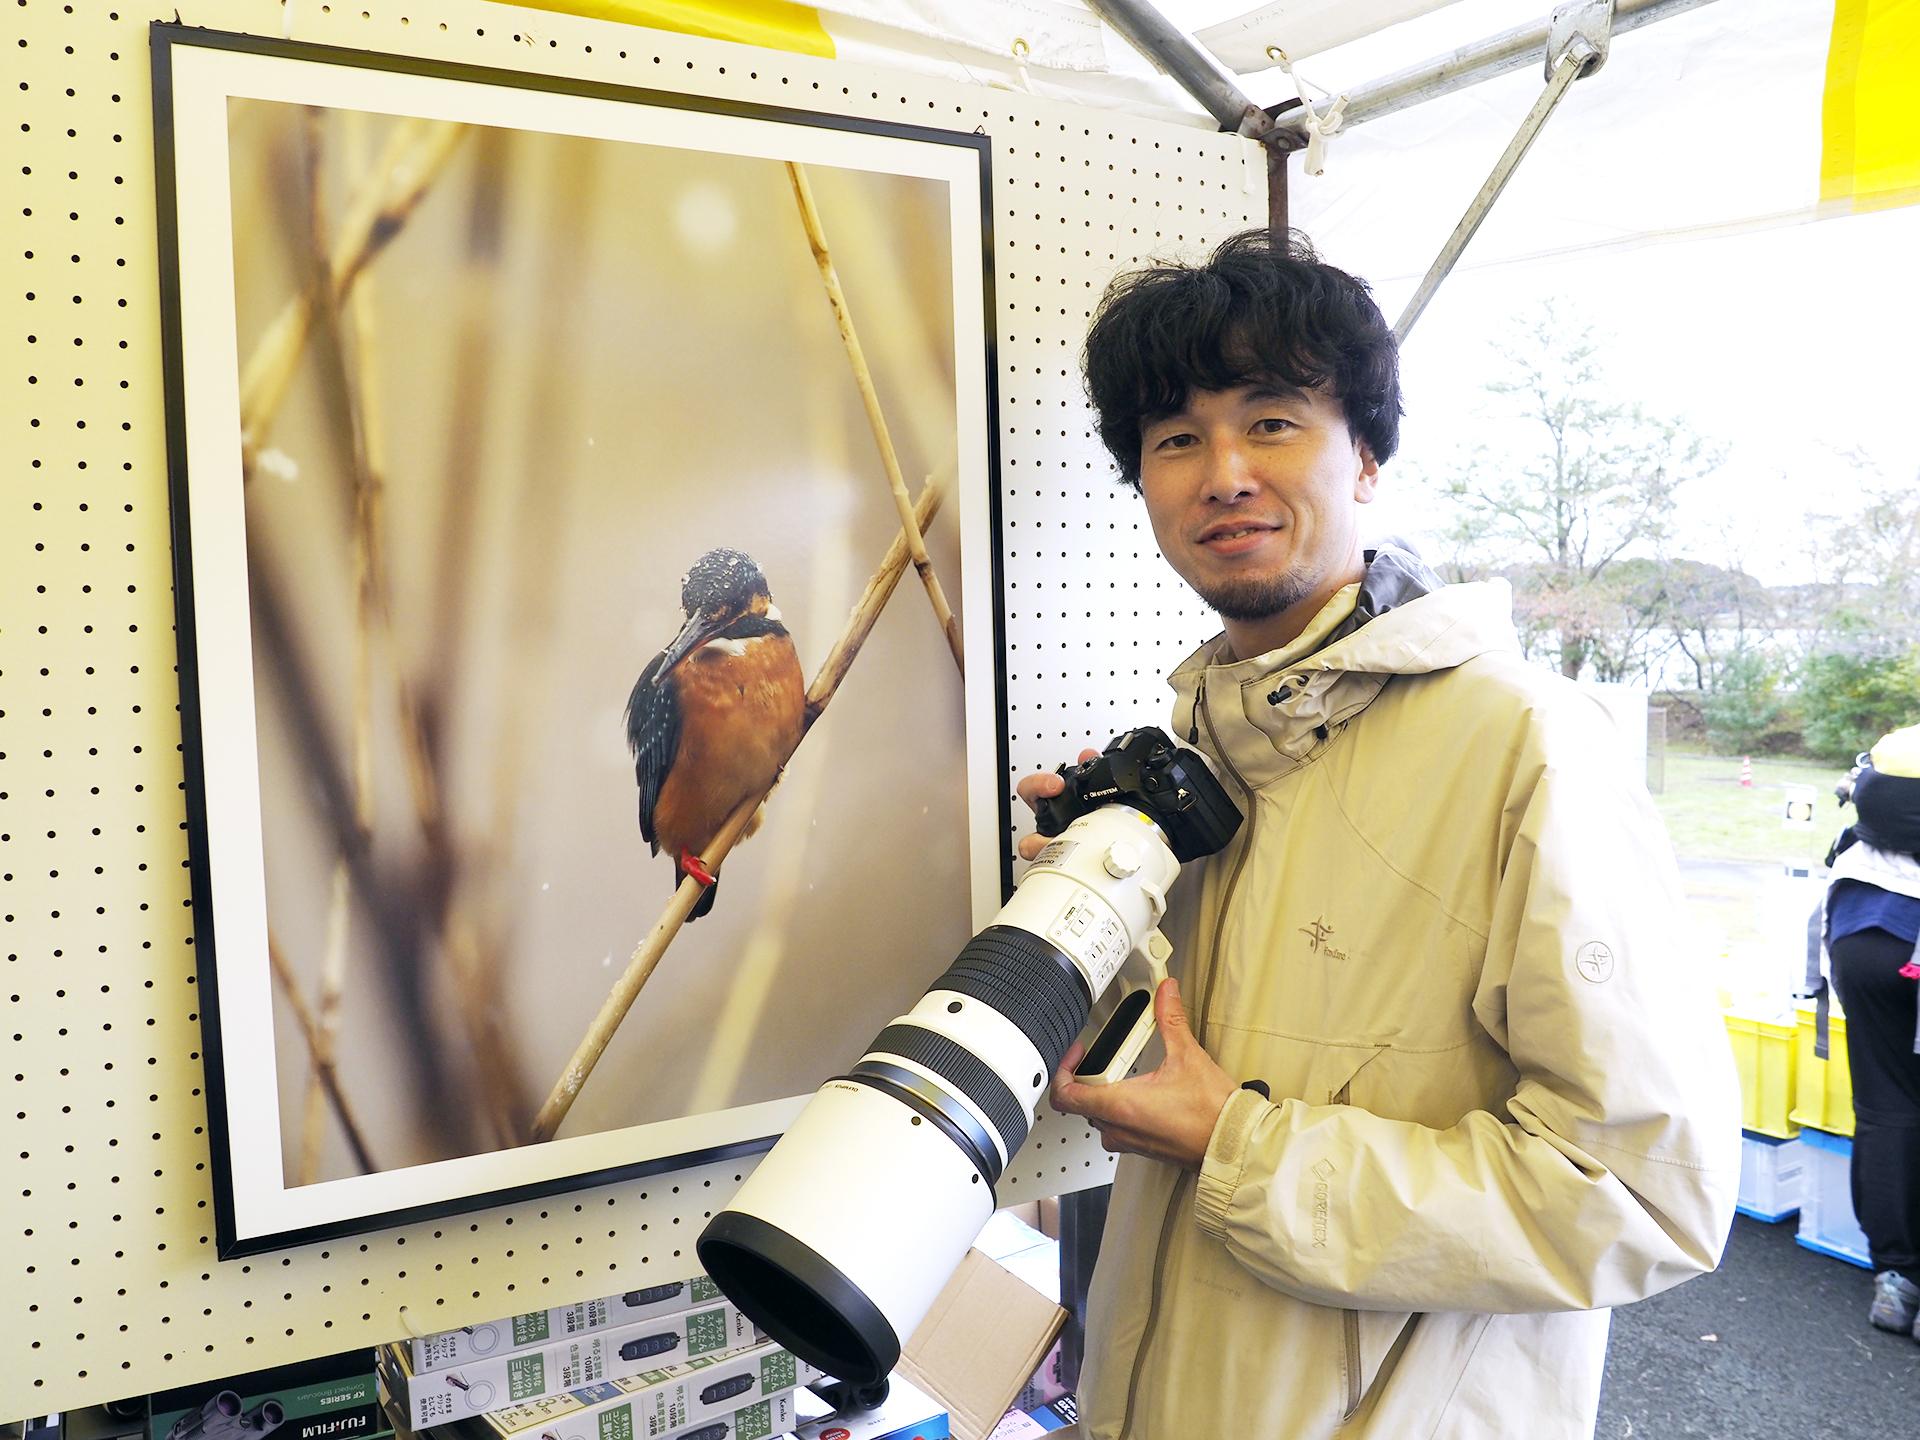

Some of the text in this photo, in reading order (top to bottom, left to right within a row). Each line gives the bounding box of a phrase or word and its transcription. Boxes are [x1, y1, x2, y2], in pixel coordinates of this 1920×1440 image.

[566, 1311, 576, 1333] 3段階
[588, 1302, 597, 1327] 10段階
[596, 1298, 606, 1324] さ調整
[697, 1316, 706, 1352] かんたん
[706, 1314, 716, 1349] スイッチで
[716, 1317, 725, 1342] 手元の
[736, 1312, 744, 1337] Kenko
[432, 1344, 440, 1361] しても
[448, 1336, 456, 1358] そのまま
[592, 1338, 602, 1378] 明るさ調整
[523, 1360, 532, 1395] コンパクト
[532, 1362, 542, 1387] 便利な
[562, 1366, 572, 1388] 3段階
[570, 1344, 581, 1386] 色温度調整
[584, 1356, 593, 1382] 10段階
[770, 1356, 780, 1391] かんたん
[779, 1353, 788, 1386] スイッチで
[786, 1354, 795, 1379] 手元の
[297, 1384, 365, 1401] Compact Binoculars
[510, 1362, 524, 1398] 三脚付き
[320, 1390, 364, 1406] KF SERIES
[428, 1396, 436, 1418] としても
[436, 1394, 444, 1415] クリップ
[444, 1392, 452, 1414] そのまま
[676, 1385, 686, 1426] 明るさ調整
[420, 1398, 428, 1424] 使用可能
[656, 1392, 666, 1433] 色温度調整
[669, 1403, 678, 1429] 10段階
[761, 1404, 770, 1428] 手元の
[622, 1413, 630, 1438] 便利な
[648, 1414, 658, 1437] 3段階
